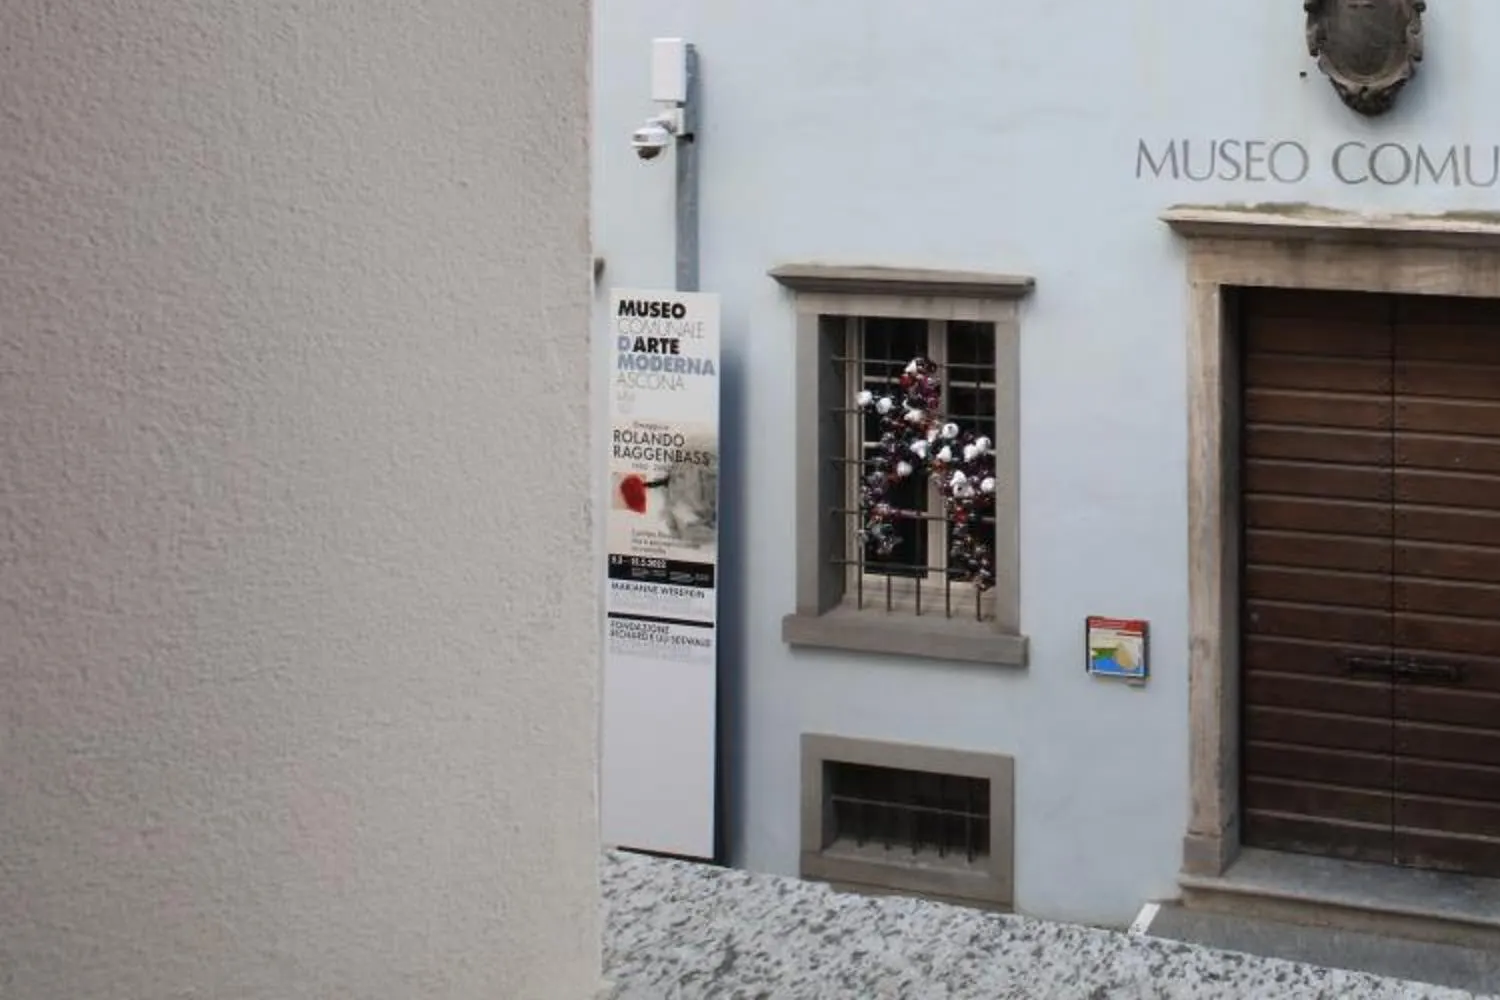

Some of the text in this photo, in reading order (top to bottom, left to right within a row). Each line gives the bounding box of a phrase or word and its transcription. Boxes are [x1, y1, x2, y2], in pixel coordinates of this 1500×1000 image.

[1135, 138, 1309, 183] MUSEO
[618, 300, 686, 319] MUSEO
[617, 354, 716, 376] MODERNA
[617, 371, 685, 391] ASCONA
[613, 429, 685, 448] ROLANDO
[613, 445, 711, 466] RAGGENBASS
